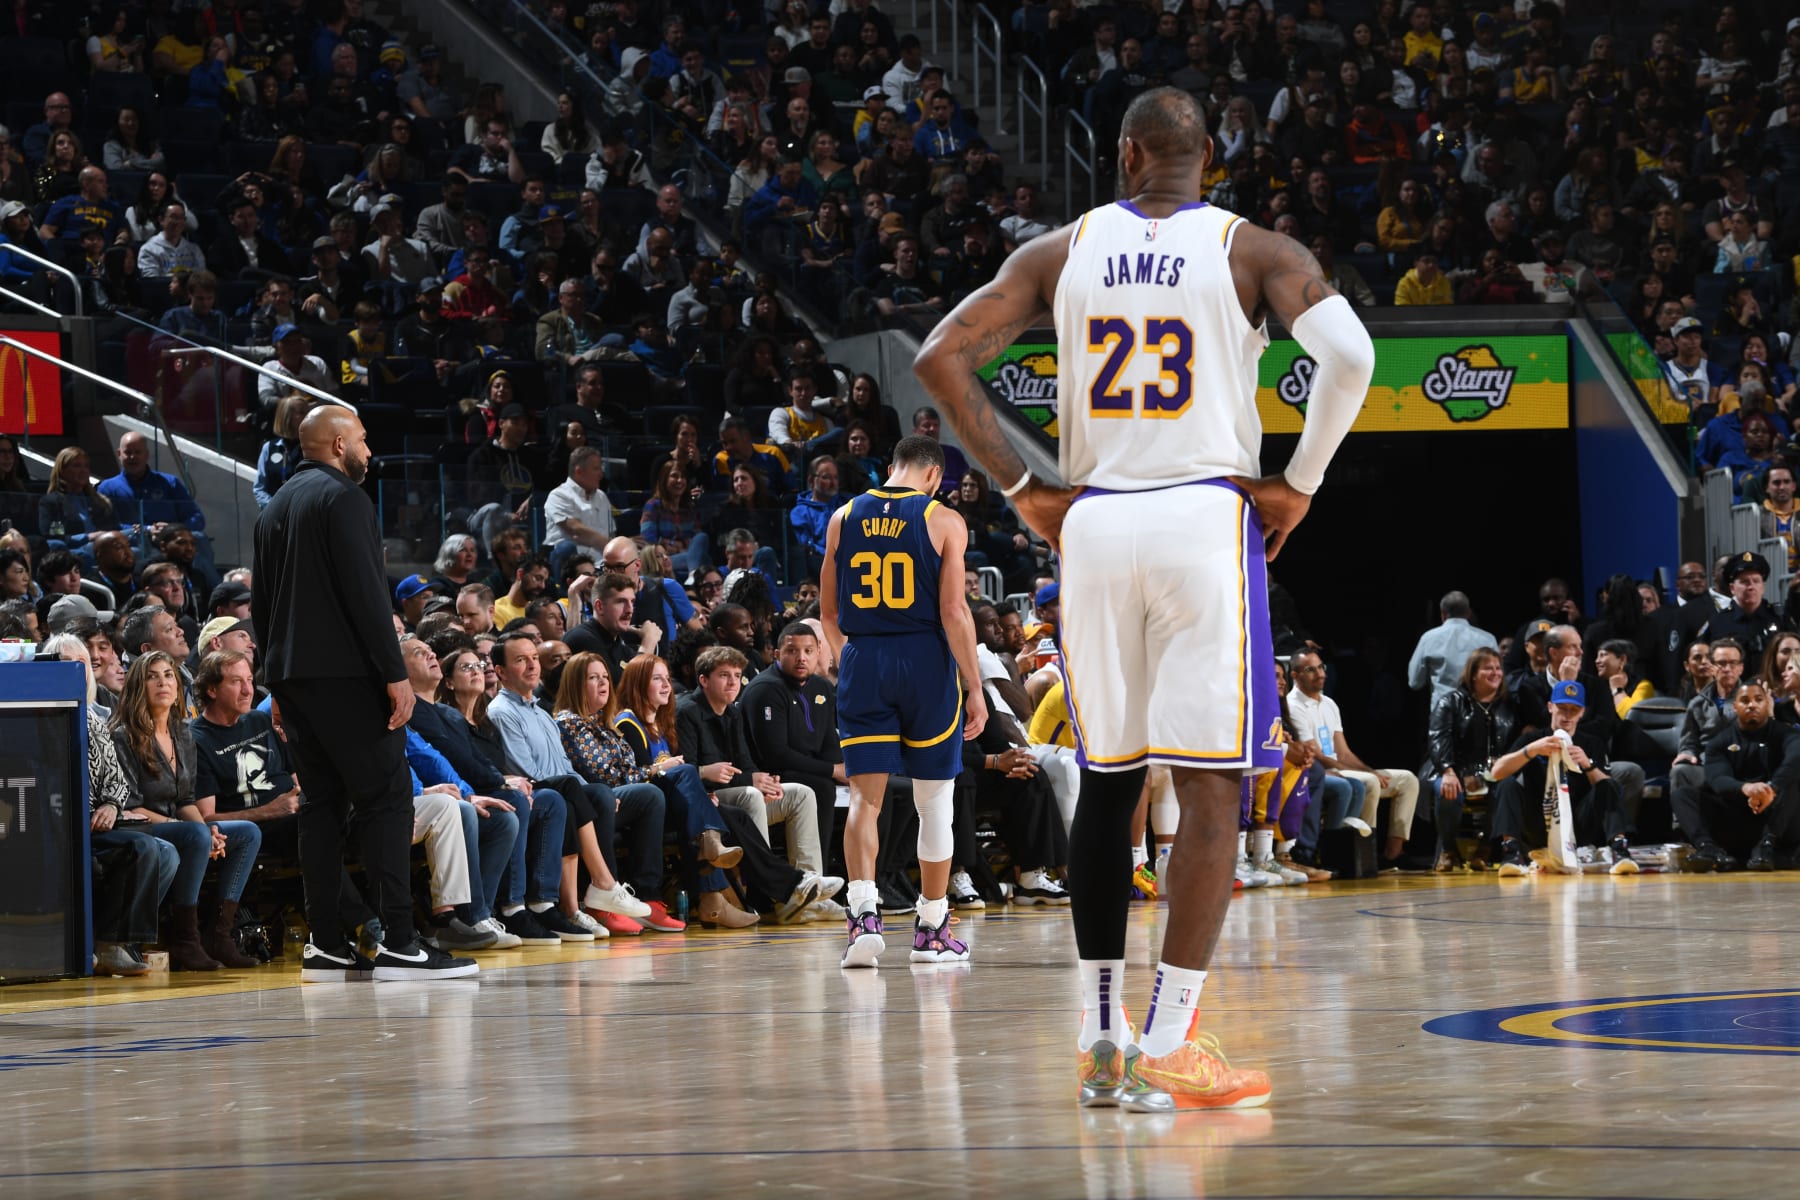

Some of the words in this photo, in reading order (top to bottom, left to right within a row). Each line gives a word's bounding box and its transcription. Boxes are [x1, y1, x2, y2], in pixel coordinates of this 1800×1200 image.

[1103, 252, 1186, 288] JAMES
[1086, 315, 1196, 420] 23
[1424, 356, 1513, 408] Starry
[861, 517, 907, 539] CURRY
[850, 551, 915, 609] 30
